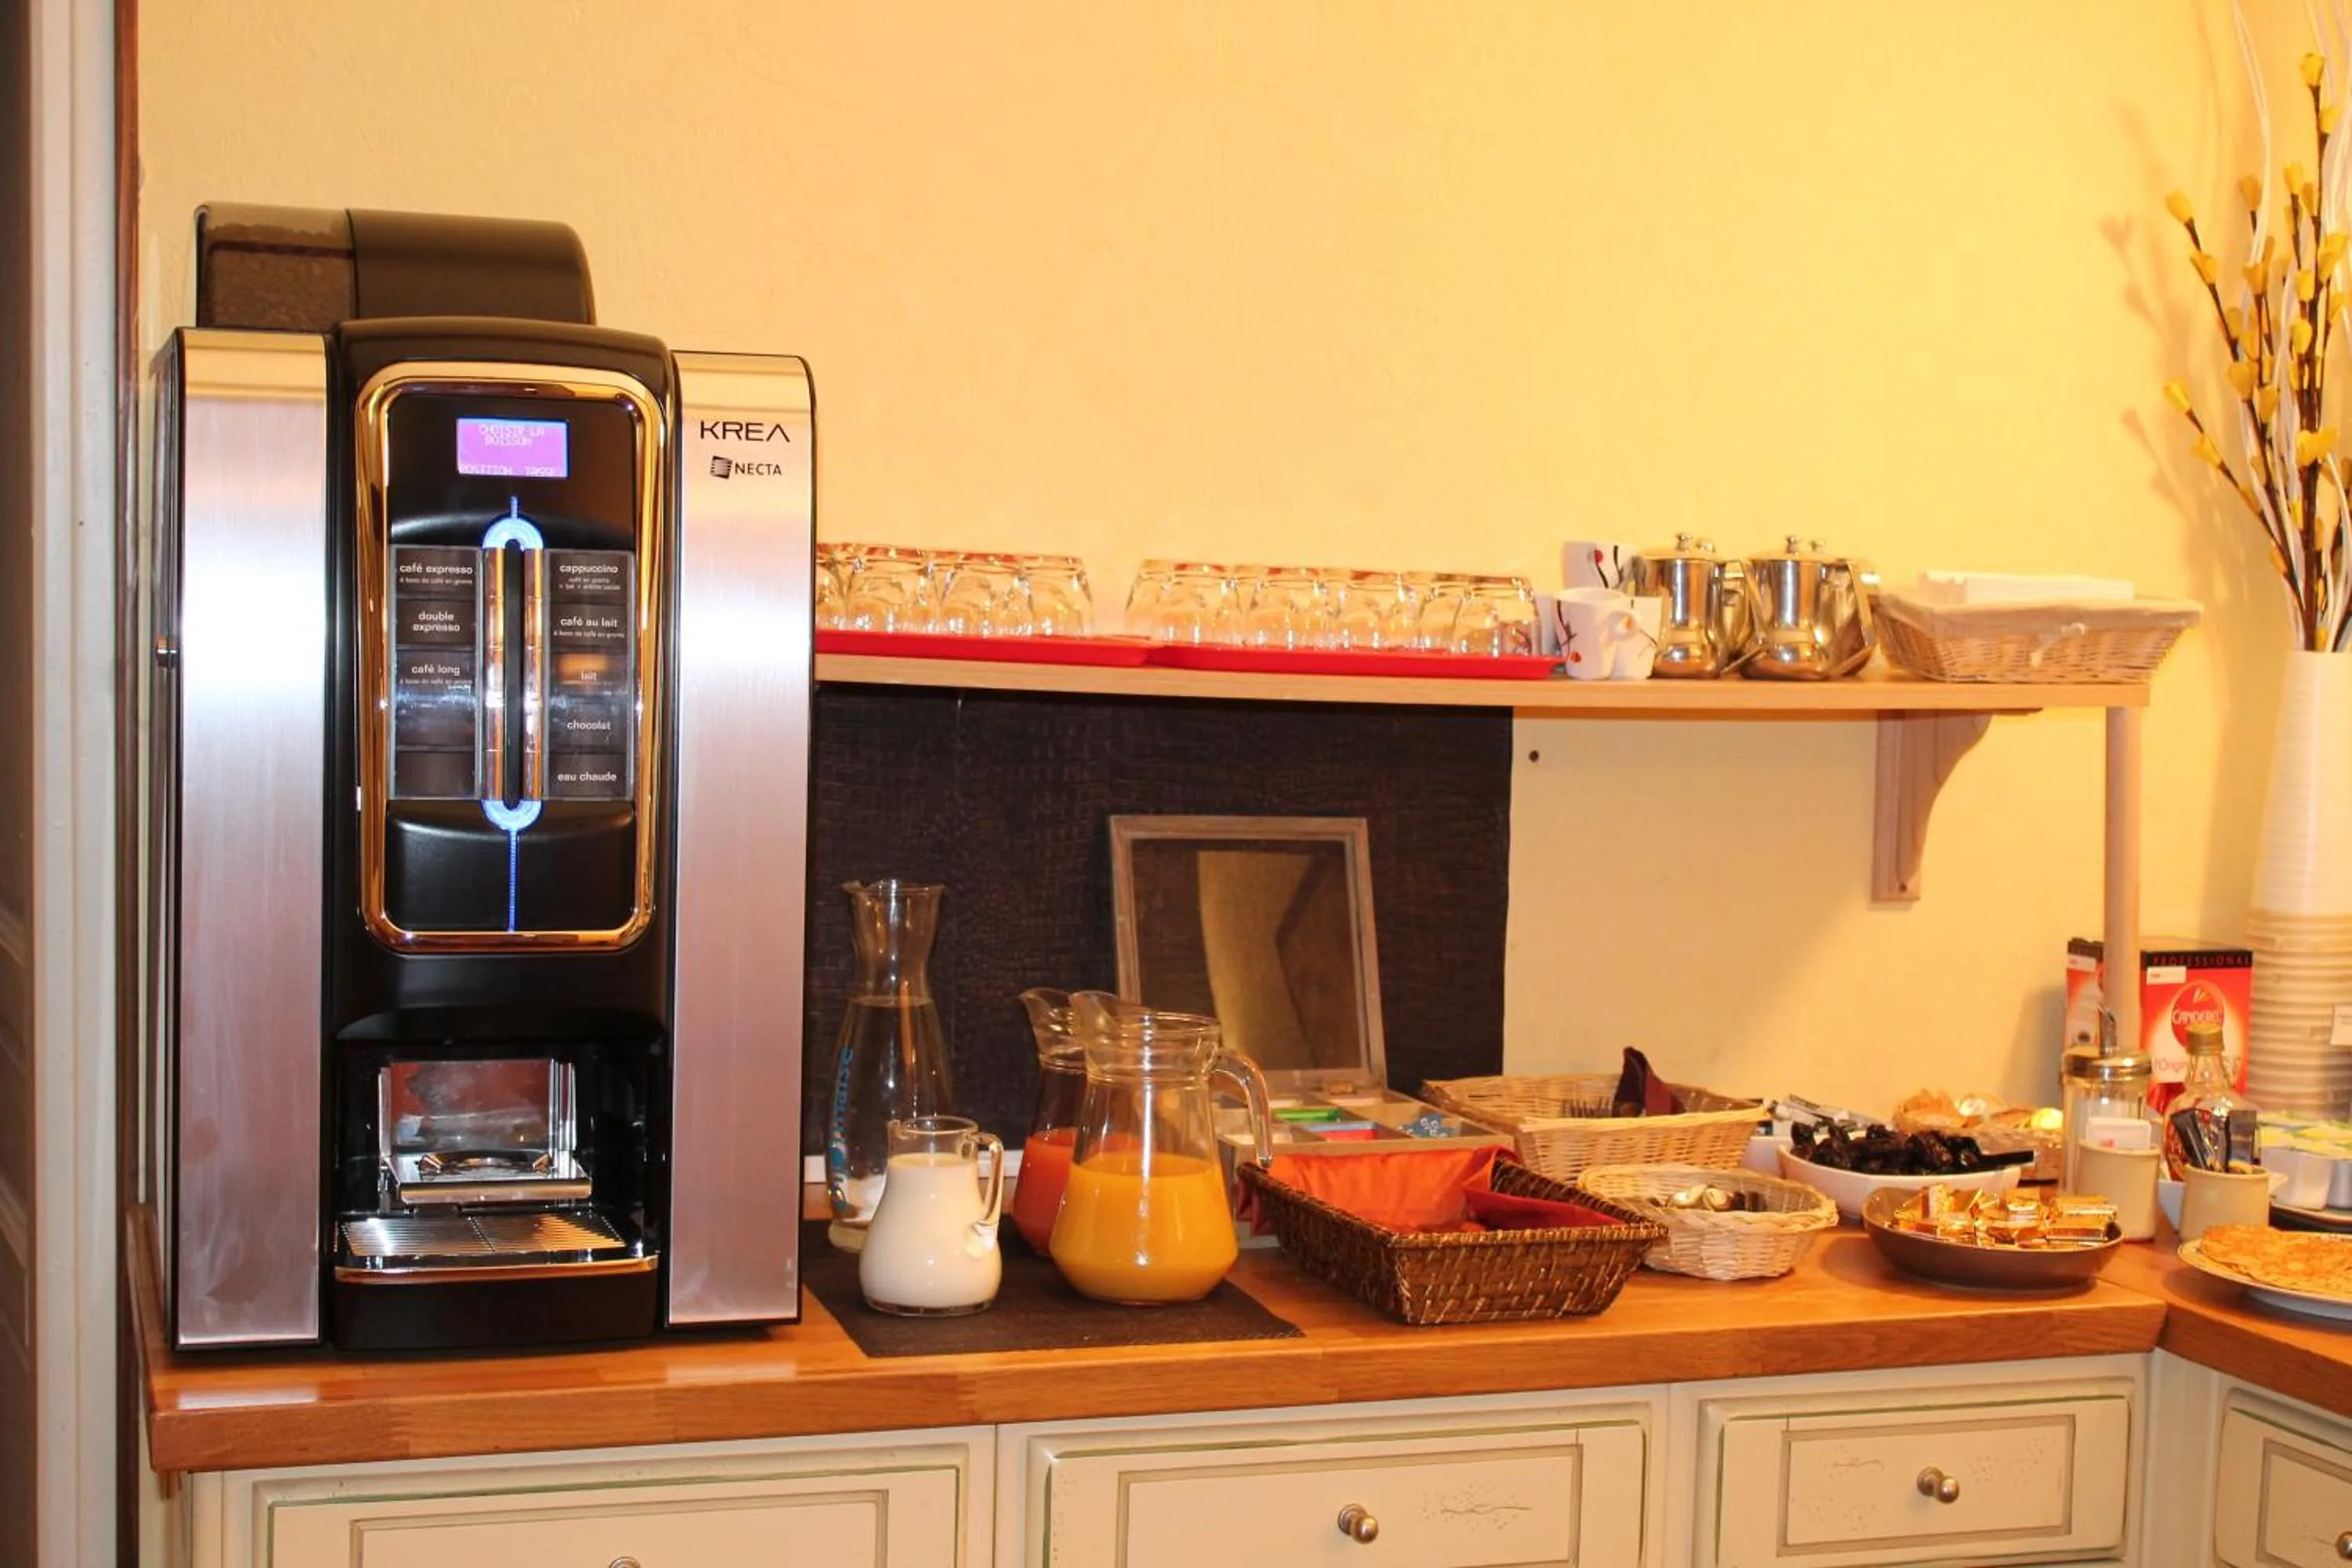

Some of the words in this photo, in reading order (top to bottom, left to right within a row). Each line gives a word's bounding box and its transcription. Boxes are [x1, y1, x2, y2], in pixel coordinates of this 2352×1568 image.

[700, 420, 790, 443] KREA
[735, 462, 782, 476] NECTA
[399, 562, 423, 574] café
[426, 565, 473, 575] expresso
[559, 564, 619, 575] cappuccino
[418, 612, 455, 621] double
[560, 616, 583, 626] café
[601, 618, 618, 627] lait
[413, 623, 460, 633] expresso
[412, 664, 435, 673] café
[437, 665, 461, 677] long
[581, 671, 598, 681] lait
[567, 720, 612, 730] chocolat
[557, 773, 577, 782] eau
[579, 771, 618, 782] chaude
[2153, 955, 2250, 967] PROFESSIONAL
